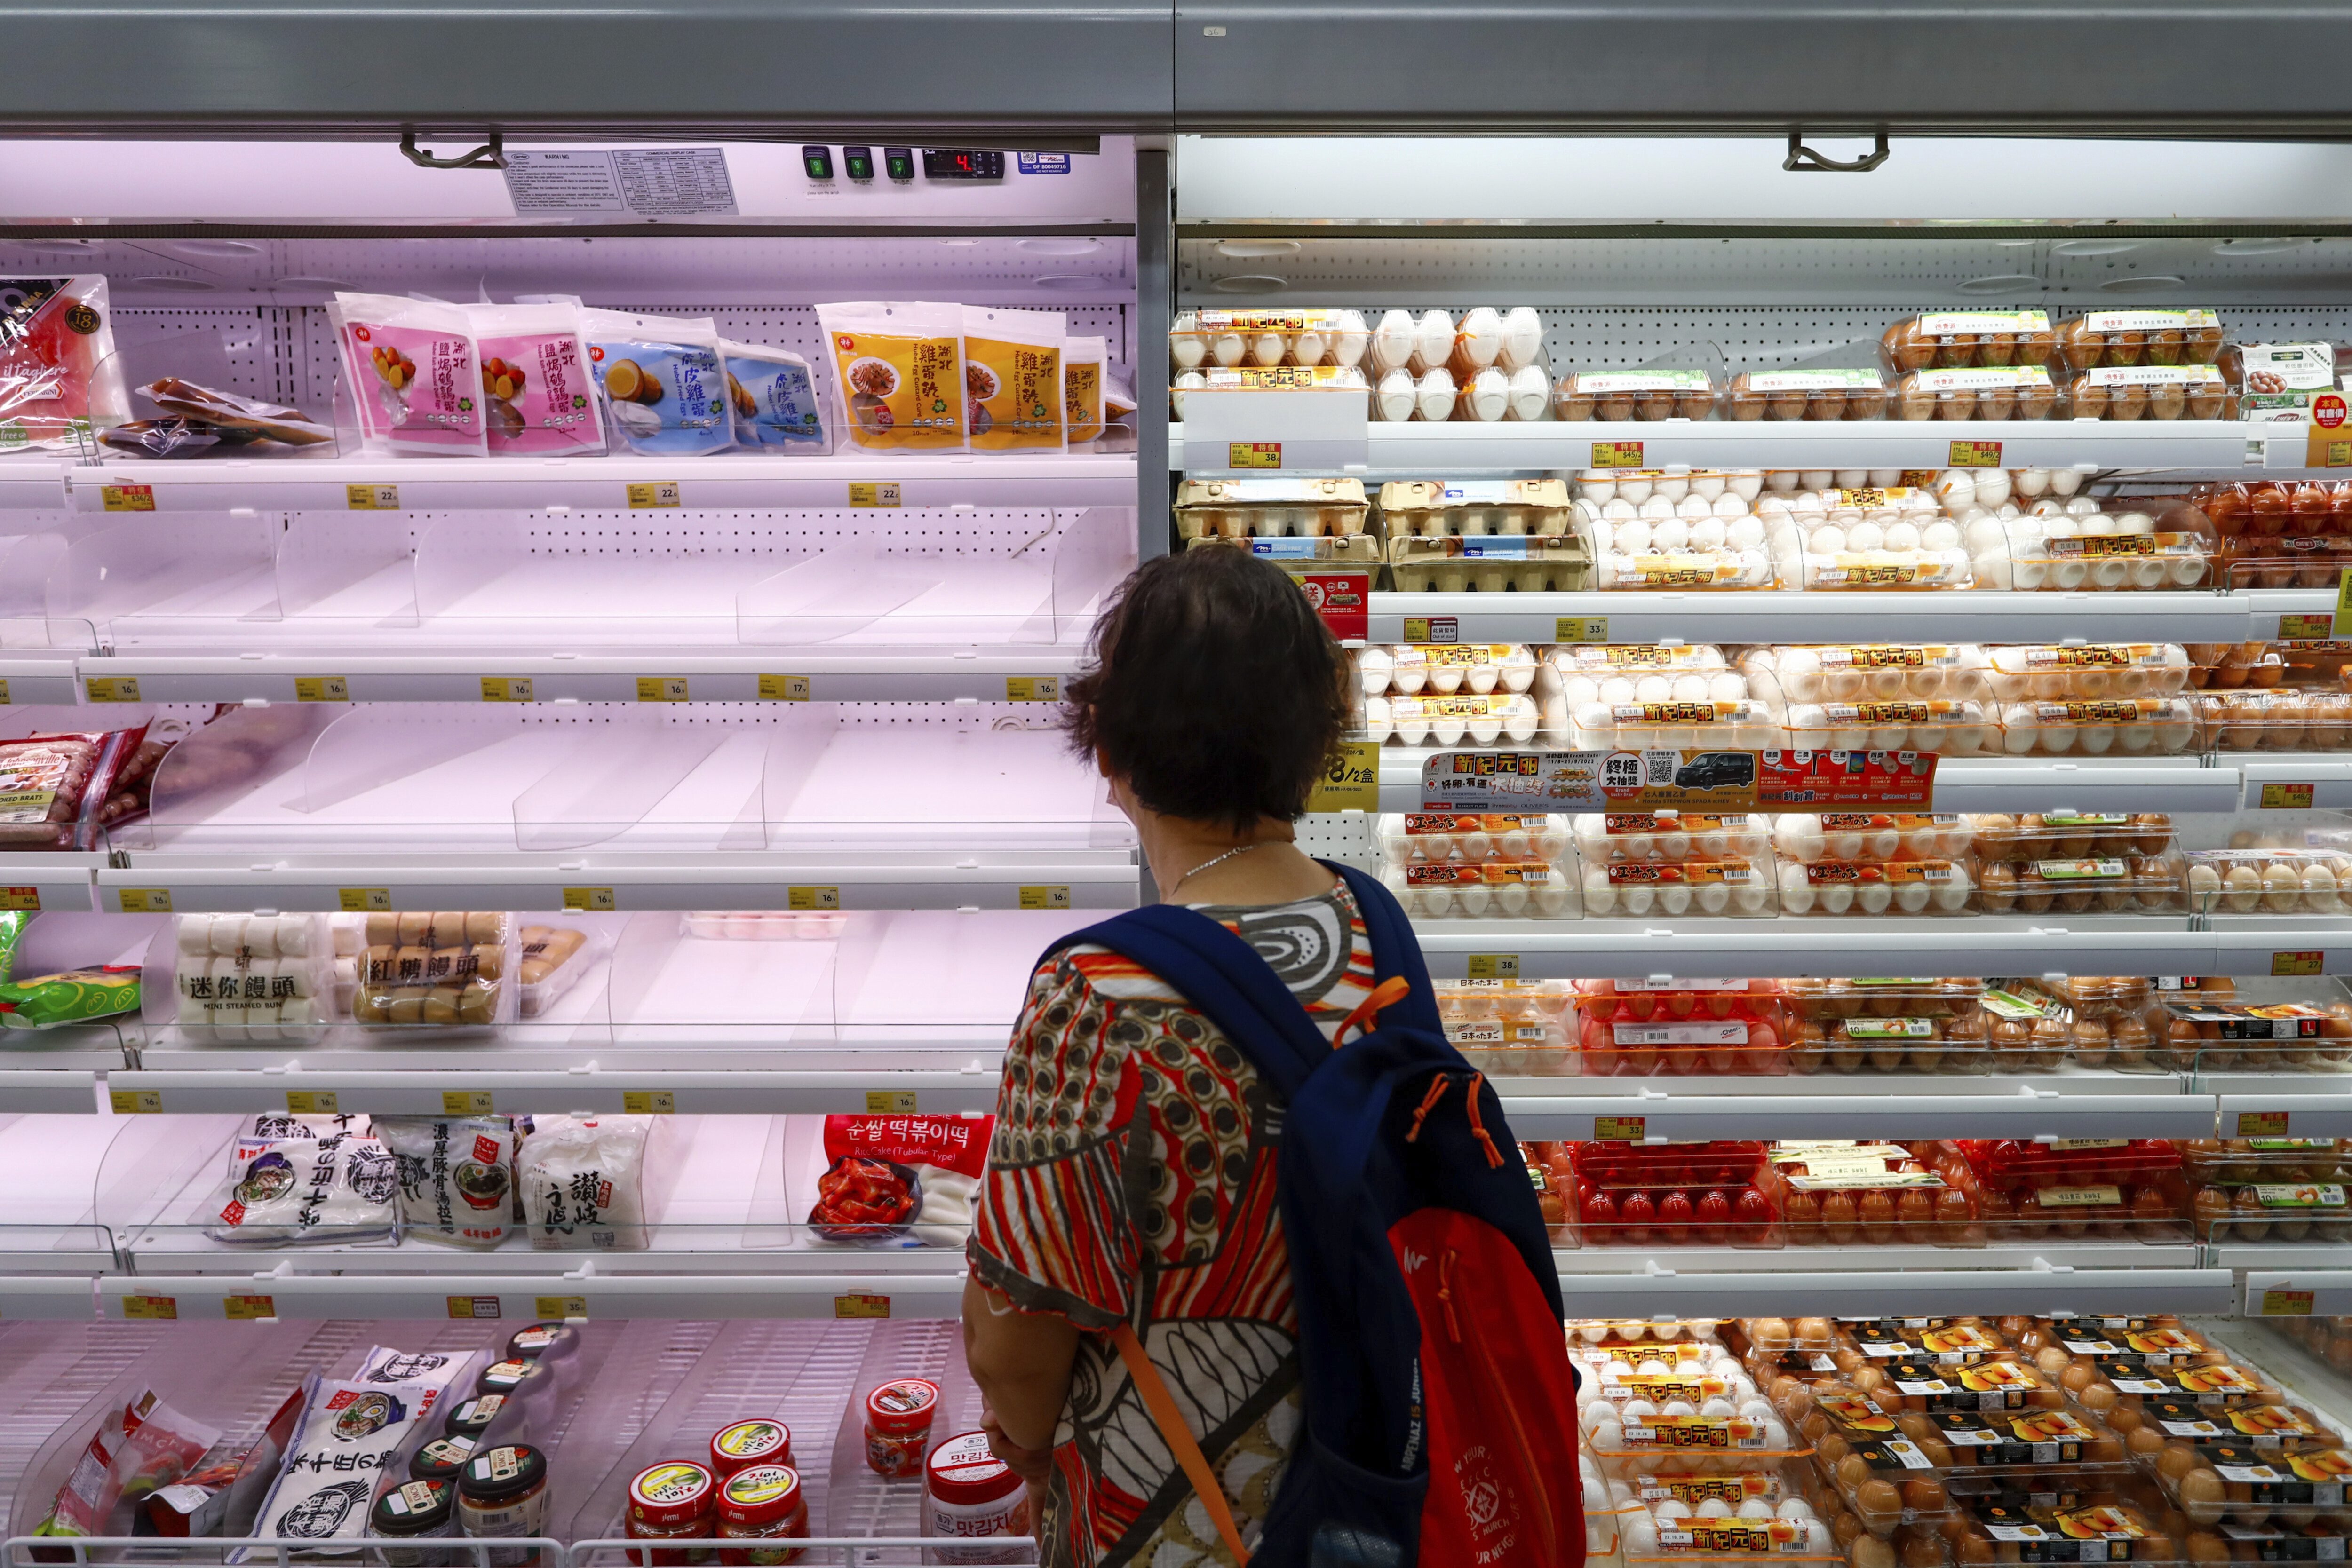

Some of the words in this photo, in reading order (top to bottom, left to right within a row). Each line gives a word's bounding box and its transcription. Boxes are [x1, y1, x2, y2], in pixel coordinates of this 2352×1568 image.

[75, 313, 91, 326] 18
[1232, 310, 1303, 329] 新紀元卵
[453, 341, 467, 369] 湖北
[559, 341, 575, 366] 湖北
[938, 345, 952, 371] 湖北
[919, 344, 940, 398] 雞蛋乾
[1040, 354, 1053, 378] 湖北
[682, 353, 707, 417] 虎皮雞蛋
[1020, 352, 1040, 404] 雞蛋乾
[1240, 368, 1312, 388] 新紀元卵
[2321, 399, 2340, 408] 本週
[2317, 408, 2344, 419] 驚喜價
[1622, 451, 1642, 459] $45/2
[381, 491, 397, 500] 22.0
[2084, 536, 2155, 555] 新紀元卵
[1646, 567, 1714, 584] 新紀元卵
[1847, 566, 1915, 583] 新紀元卵
[2310, 623, 2329, 632] $64/2
[1426, 647, 1489, 665] 新紀元卵
[1606, 647, 1669, 665] 新紀元卵
[1851, 648, 1923, 667] 新紀元卵
[2057, 646, 2129, 665] 新紀元卵
[1423, 697, 1488, 715] 新紀元卵
[1645, 702, 1714, 722] 新紀元卵
[1857, 703, 1928, 722] 新紀元卵
[2066, 702, 2137, 721] 新紀元卵
[5, 754, 61, 769] Johnsonville
[1453, 753, 1539, 776] 新紀元卵
[1606, 760, 1638, 774] 終極
[1488, 776, 1545, 796] 大抽獎
[1606, 776, 1638, 786] 大抽獎
[2042, 867, 2053, 876] 10
[369, 953, 480, 982] 紅糖饅頭
[190, 975, 296, 1000] 迷你饅頭
[1460, 979, 1499, 988] 日本のたまご
[1722, 1027, 1740, 1037] Cheer
[1850, 1027, 1860, 1036] 10
[2306, 1021, 2313, 1031] L
[1461, 1032, 1500, 1041] 日本のたまご
[846, 1119, 886, 1141] 순쌀
[889, 1118, 969, 1148] 떡볶이떡
[854, 1147, 870, 1156] Rice
[871, 1147, 891, 1156] Cake
[893, 1146, 928, 1156] (Tubular
[932, 1149, 956, 1163] Type)
[2261, 1195, 2273, 1204] 10
[1413, 1358, 1421, 1404] JUNIOR
[1655, 1425, 1728, 1447] 新紀元卵
[1463, 1446, 1486, 1461] YOUR
[2066, 1445, 2077, 1456] XL
[957, 1513, 1009, 1538] 맛김치
[1692, 1528, 1769, 1552] 新紀元卵
[2115, 1543, 2125, 1555] XL
